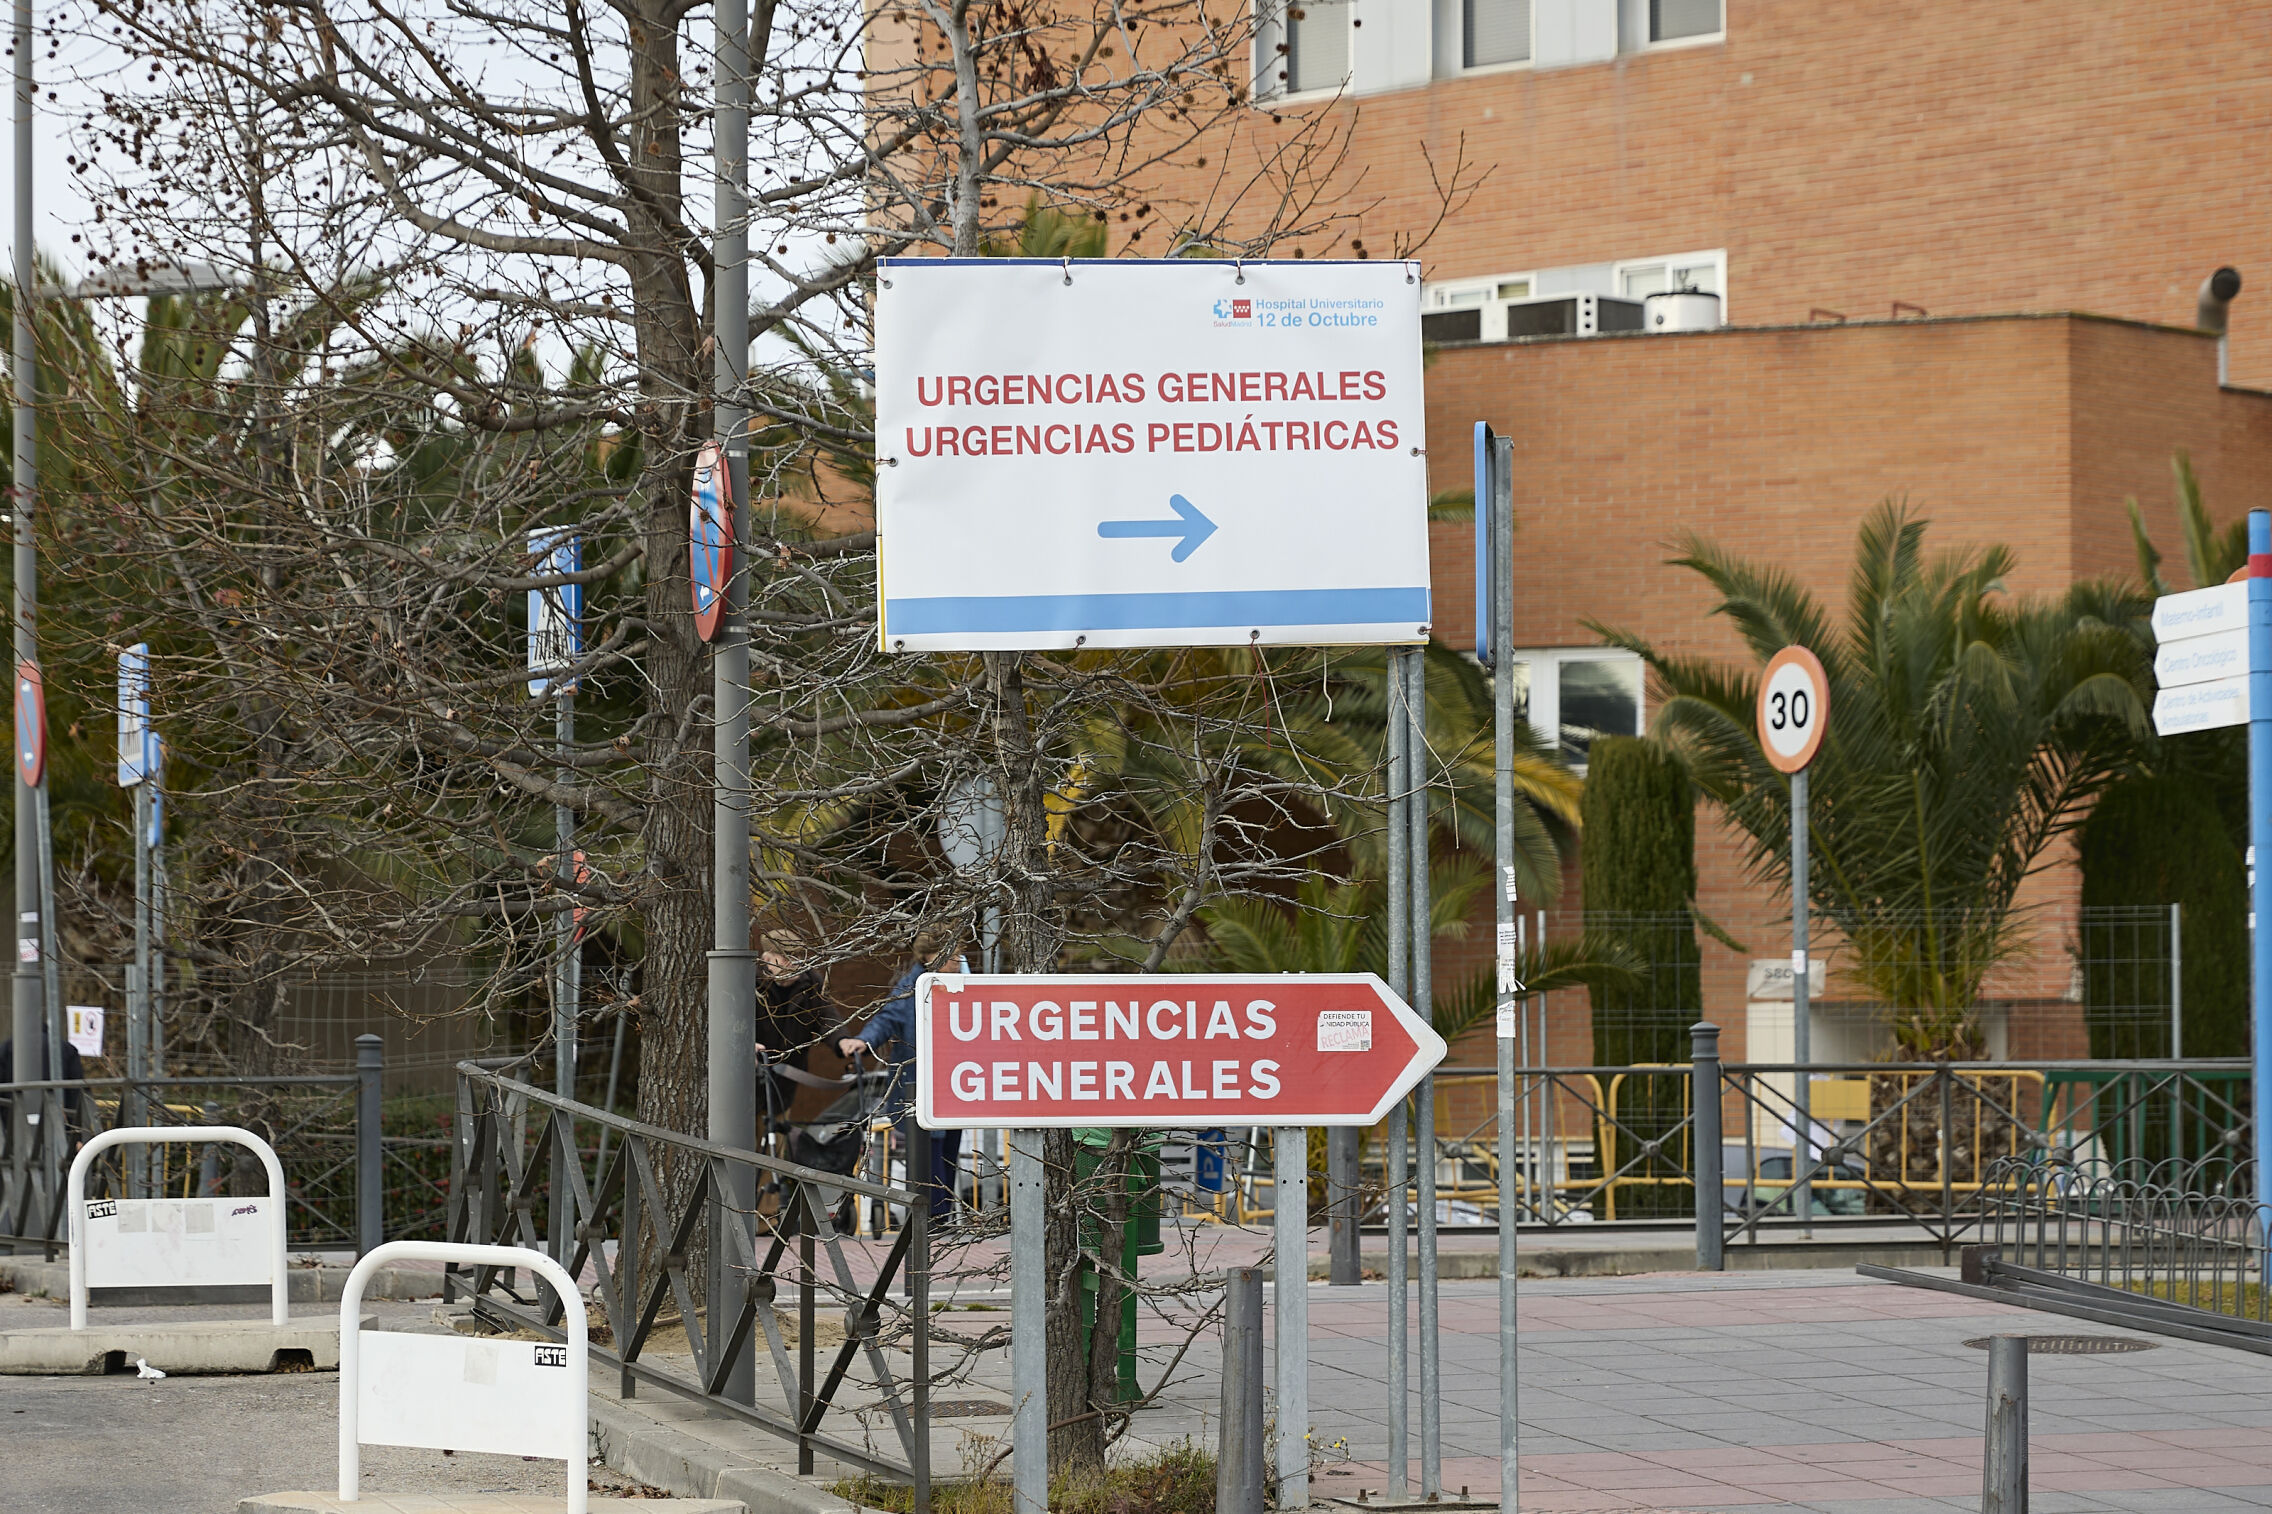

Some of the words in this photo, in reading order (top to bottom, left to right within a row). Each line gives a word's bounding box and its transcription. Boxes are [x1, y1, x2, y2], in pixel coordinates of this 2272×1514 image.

[1256, 299, 1306, 311] Hospital
[1310, 299, 1384, 309] Universitario
[1257, 313, 1276, 327] 12
[1281, 313, 1302, 327] de
[1308, 312, 1377, 327] Octubre
[917, 373, 1146, 407] URGENCIAS
[1157, 370, 1387, 403] GENERALES
[906, 423, 1135, 457] URGENCIAS
[1147, 413, 1399, 453] PEDIÁTRICAS
[1771, 690, 1809, 730] 30
[949, 1000, 1277, 1042] URGENCIAS
[1321, 1025, 1369, 1048] RECLAMA
[950, 1059, 1281, 1102] GENERALES
[88, 1202, 116, 1218] ASTE
[535, 1347, 566, 1366] ASTE
